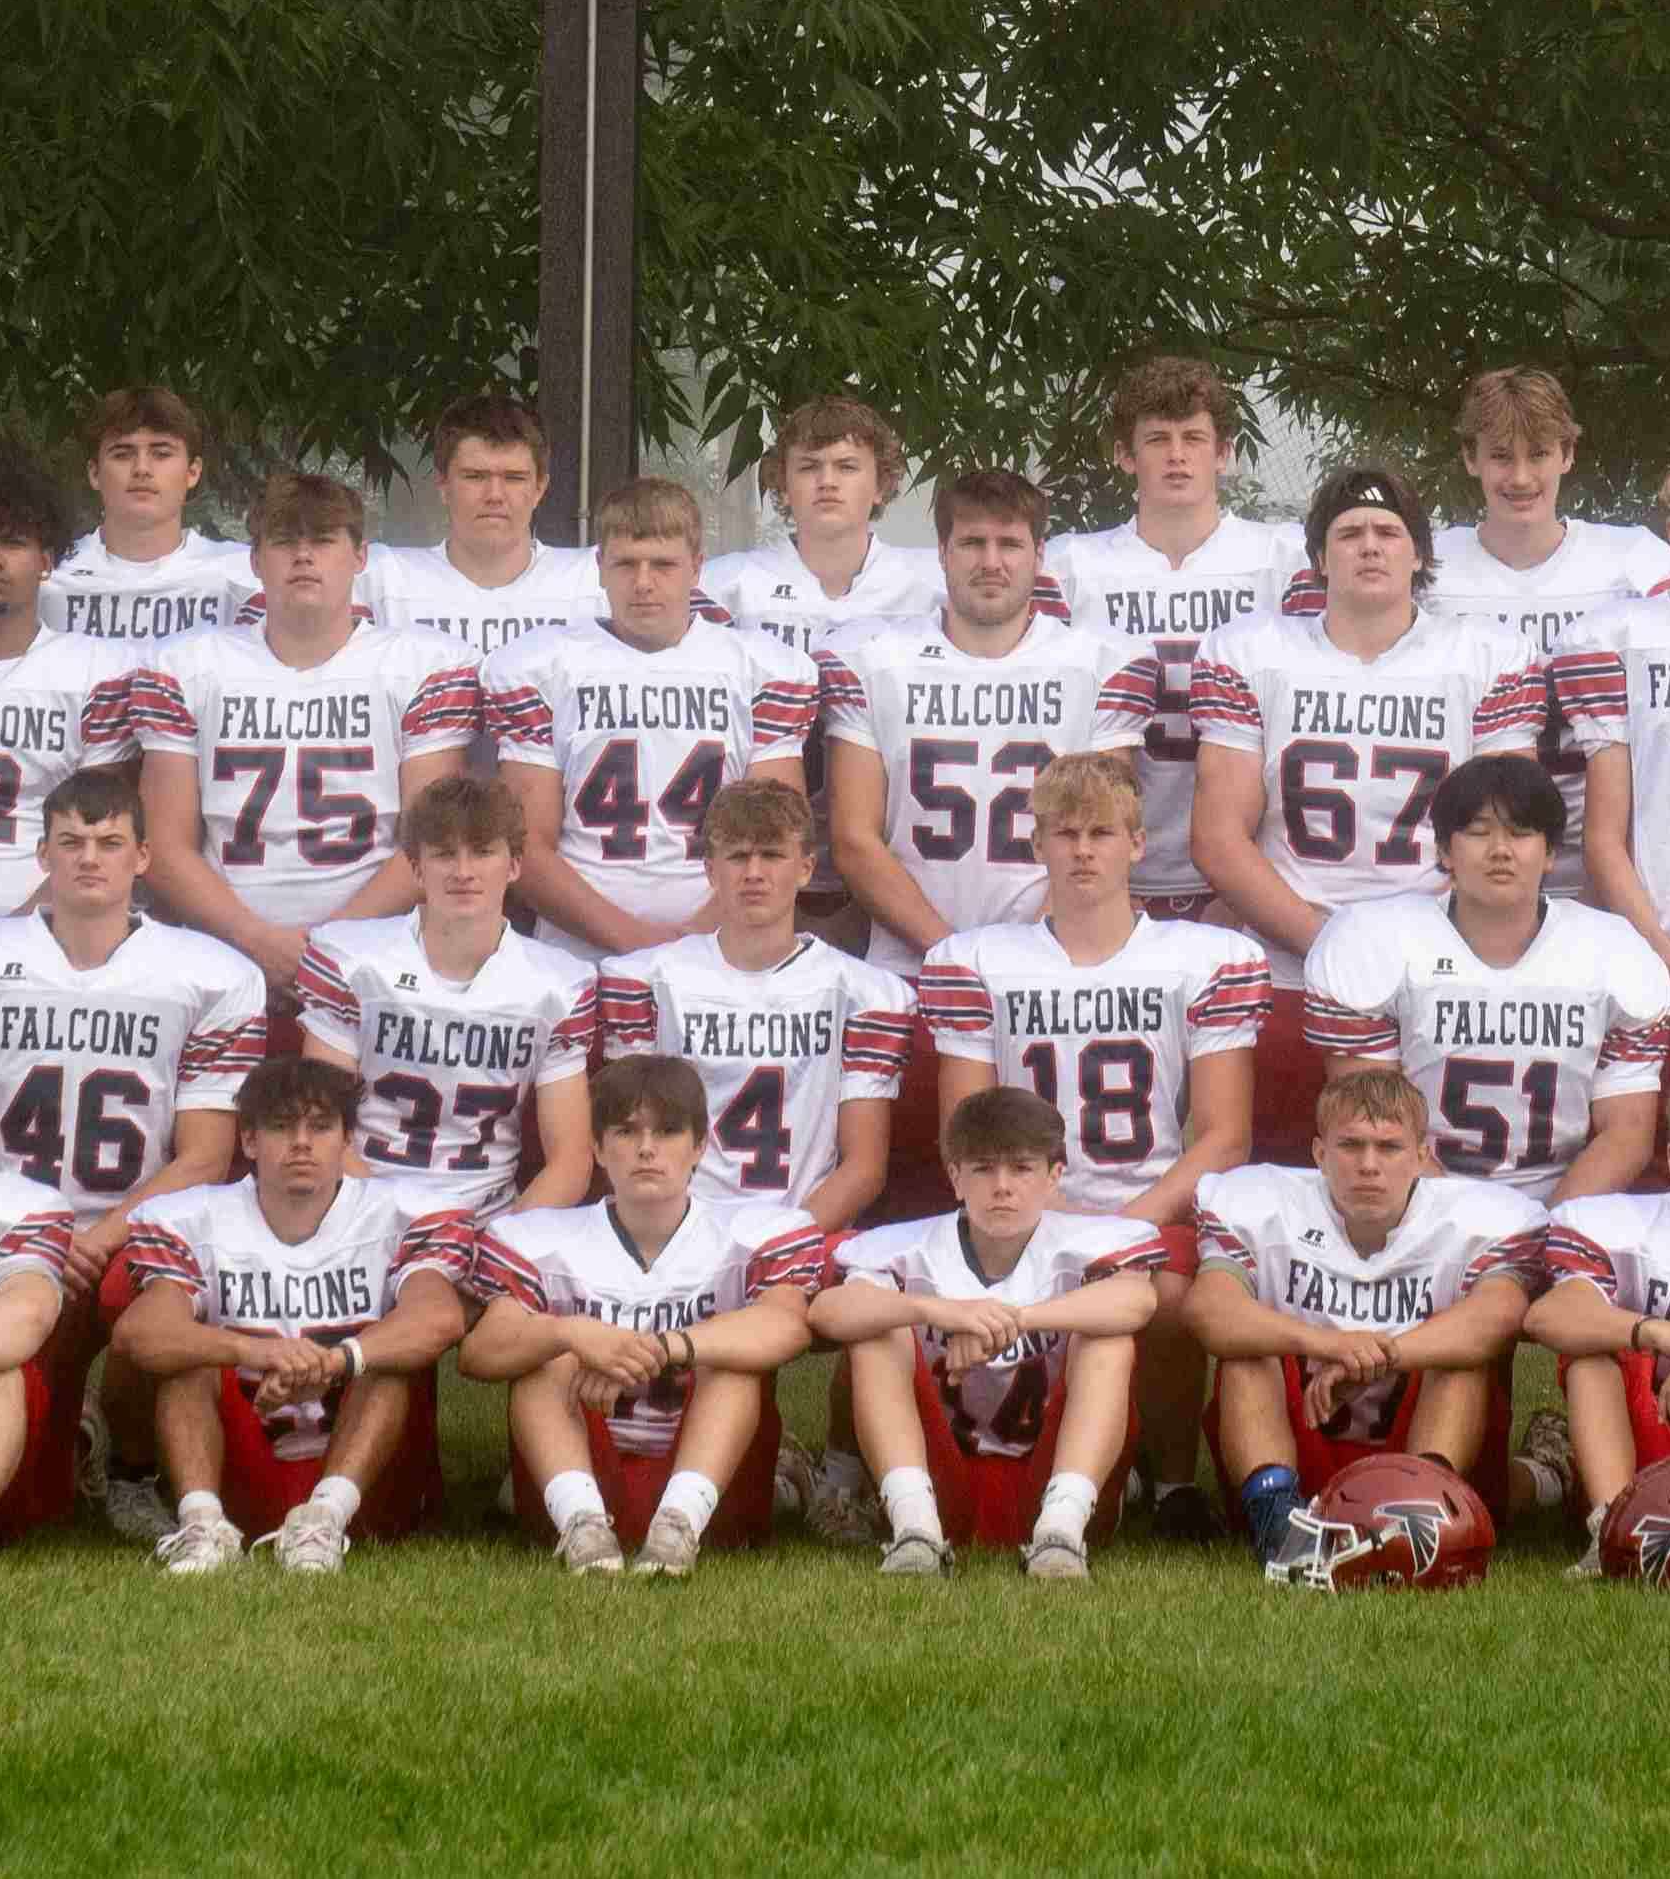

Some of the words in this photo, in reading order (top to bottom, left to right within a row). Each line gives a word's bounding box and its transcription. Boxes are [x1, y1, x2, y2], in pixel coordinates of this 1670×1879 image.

[65, 593, 219, 639] FALCONS
[1105, 588, 1255, 635] FALCONS
[219, 694, 372, 741] FALCONS
[576, 684, 730, 733] FALCONS
[905, 680, 1064, 726] FALCONS
[1291, 688, 1447, 741] FALCONS
[212, 745, 378, 867] 75
[573, 738, 728, 861] 44
[909, 737, 1059, 864] 52
[1280, 738, 1452, 867] 67
[0, 1005, 162, 1060] FALCONS
[682, 1009, 834, 1058] FALCONS
[1006, 985, 1165, 1036] FALCONS
[1433, 999, 1586, 1049] FALCONS
[374, 1010, 536, 1071] FALCONS
[0, 1064, 153, 1194] 46
[361, 1070, 521, 1172] 37
[713, 1064, 793, 1191] 4
[1021, 1038, 1158, 1165] 18
[1433, 1055, 1560, 1178] 51
[218, 1265, 373, 1321] FALCONS
[1284, 1258, 1436, 1323] FALCONS
